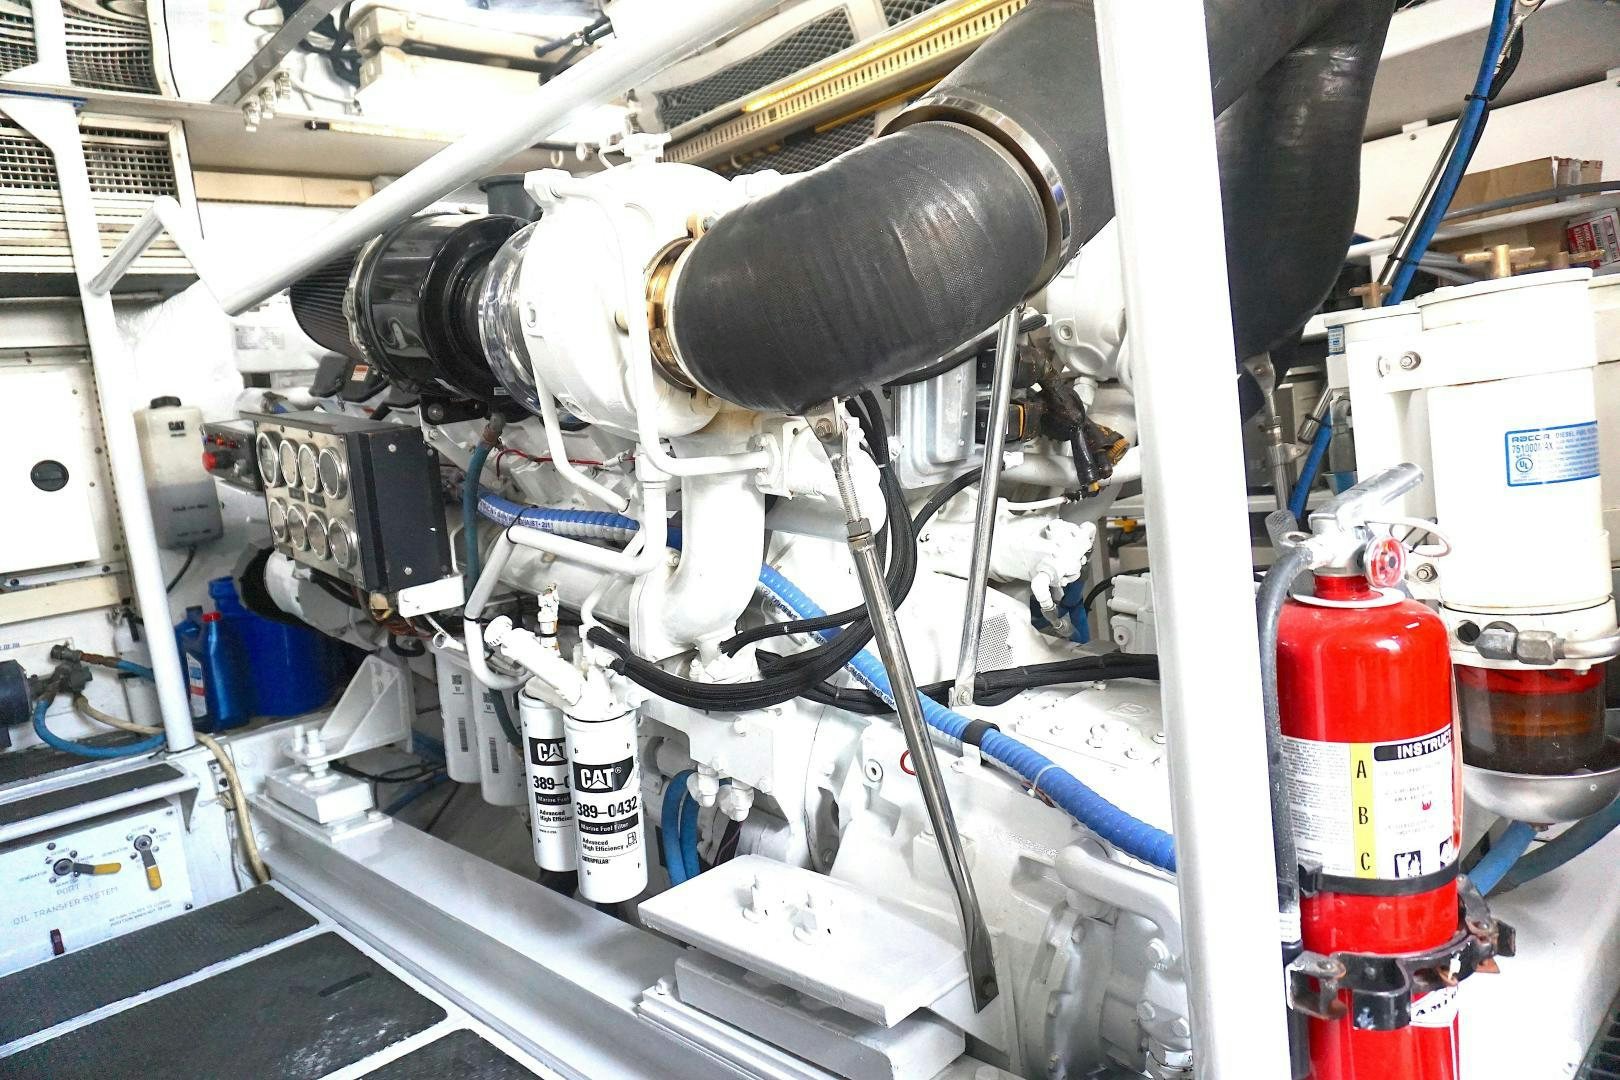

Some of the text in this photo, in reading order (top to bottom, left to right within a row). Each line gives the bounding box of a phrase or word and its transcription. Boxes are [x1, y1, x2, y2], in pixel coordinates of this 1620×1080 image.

[1356, 760, 1367, 778] A
[580, 768, 614, 789] CAT
[576, 796, 637, 818] 389-0432
[1358, 806, 1369, 825] B
[540, 815, 551, 823] High
[580, 823, 599, 832] Marine
[614, 822, 629, 830] Filter
[582, 837, 609, 845] Advanced
[582, 843, 624, 852] High Efficiency
[1360, 852, 1371, 871] C
[13, 886, 118, 925] OIL TRANSFER SYSTEM
